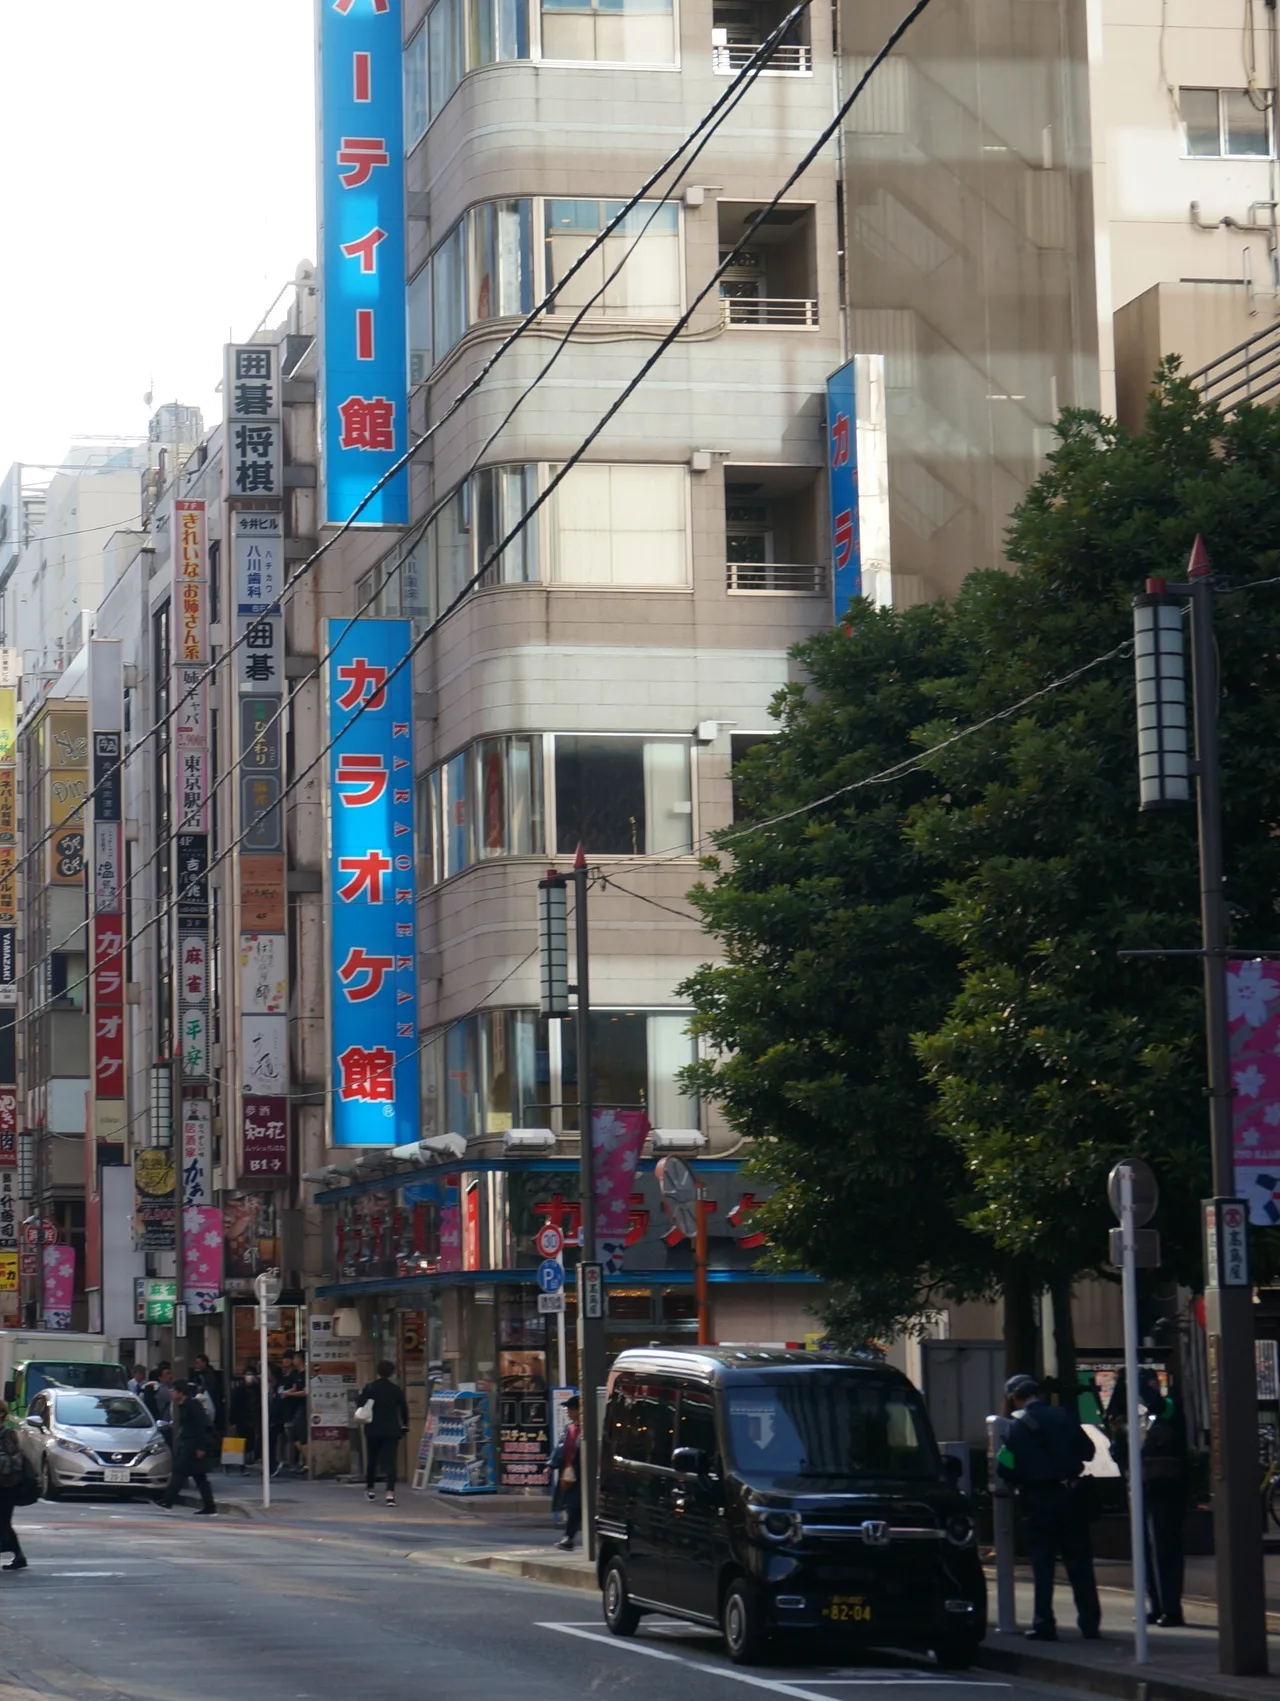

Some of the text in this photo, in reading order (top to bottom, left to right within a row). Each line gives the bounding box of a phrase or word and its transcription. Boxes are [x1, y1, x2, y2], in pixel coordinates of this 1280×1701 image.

[332, 0, 395, 451] ーティー館
[235, 349, 273, 416] 囲碁
[235, 425, 274, 492] 将棋
[831, 411, 854, 571] カラ
[239, 518, 278, 530] 今井ビル
[247, 546, 262, 599] 八川歯科
[246, 622, 275, 681] 囲碁
[183, 755, 202, 828] 東京駅店
[336, 657, 396, 1103] カラオケ館
[2, 933, 11, 981] YAMAZAKI
[184, 946, 203, 993] 麻雀
[96, 931, 122, 1078] カラオケ
[186, 1019, 202, 1066] 平安
[245, 1119, 285, 1140] 知花
[543, 1234, 558, 1249] 30
[543, 1268, 554, 1289] P
